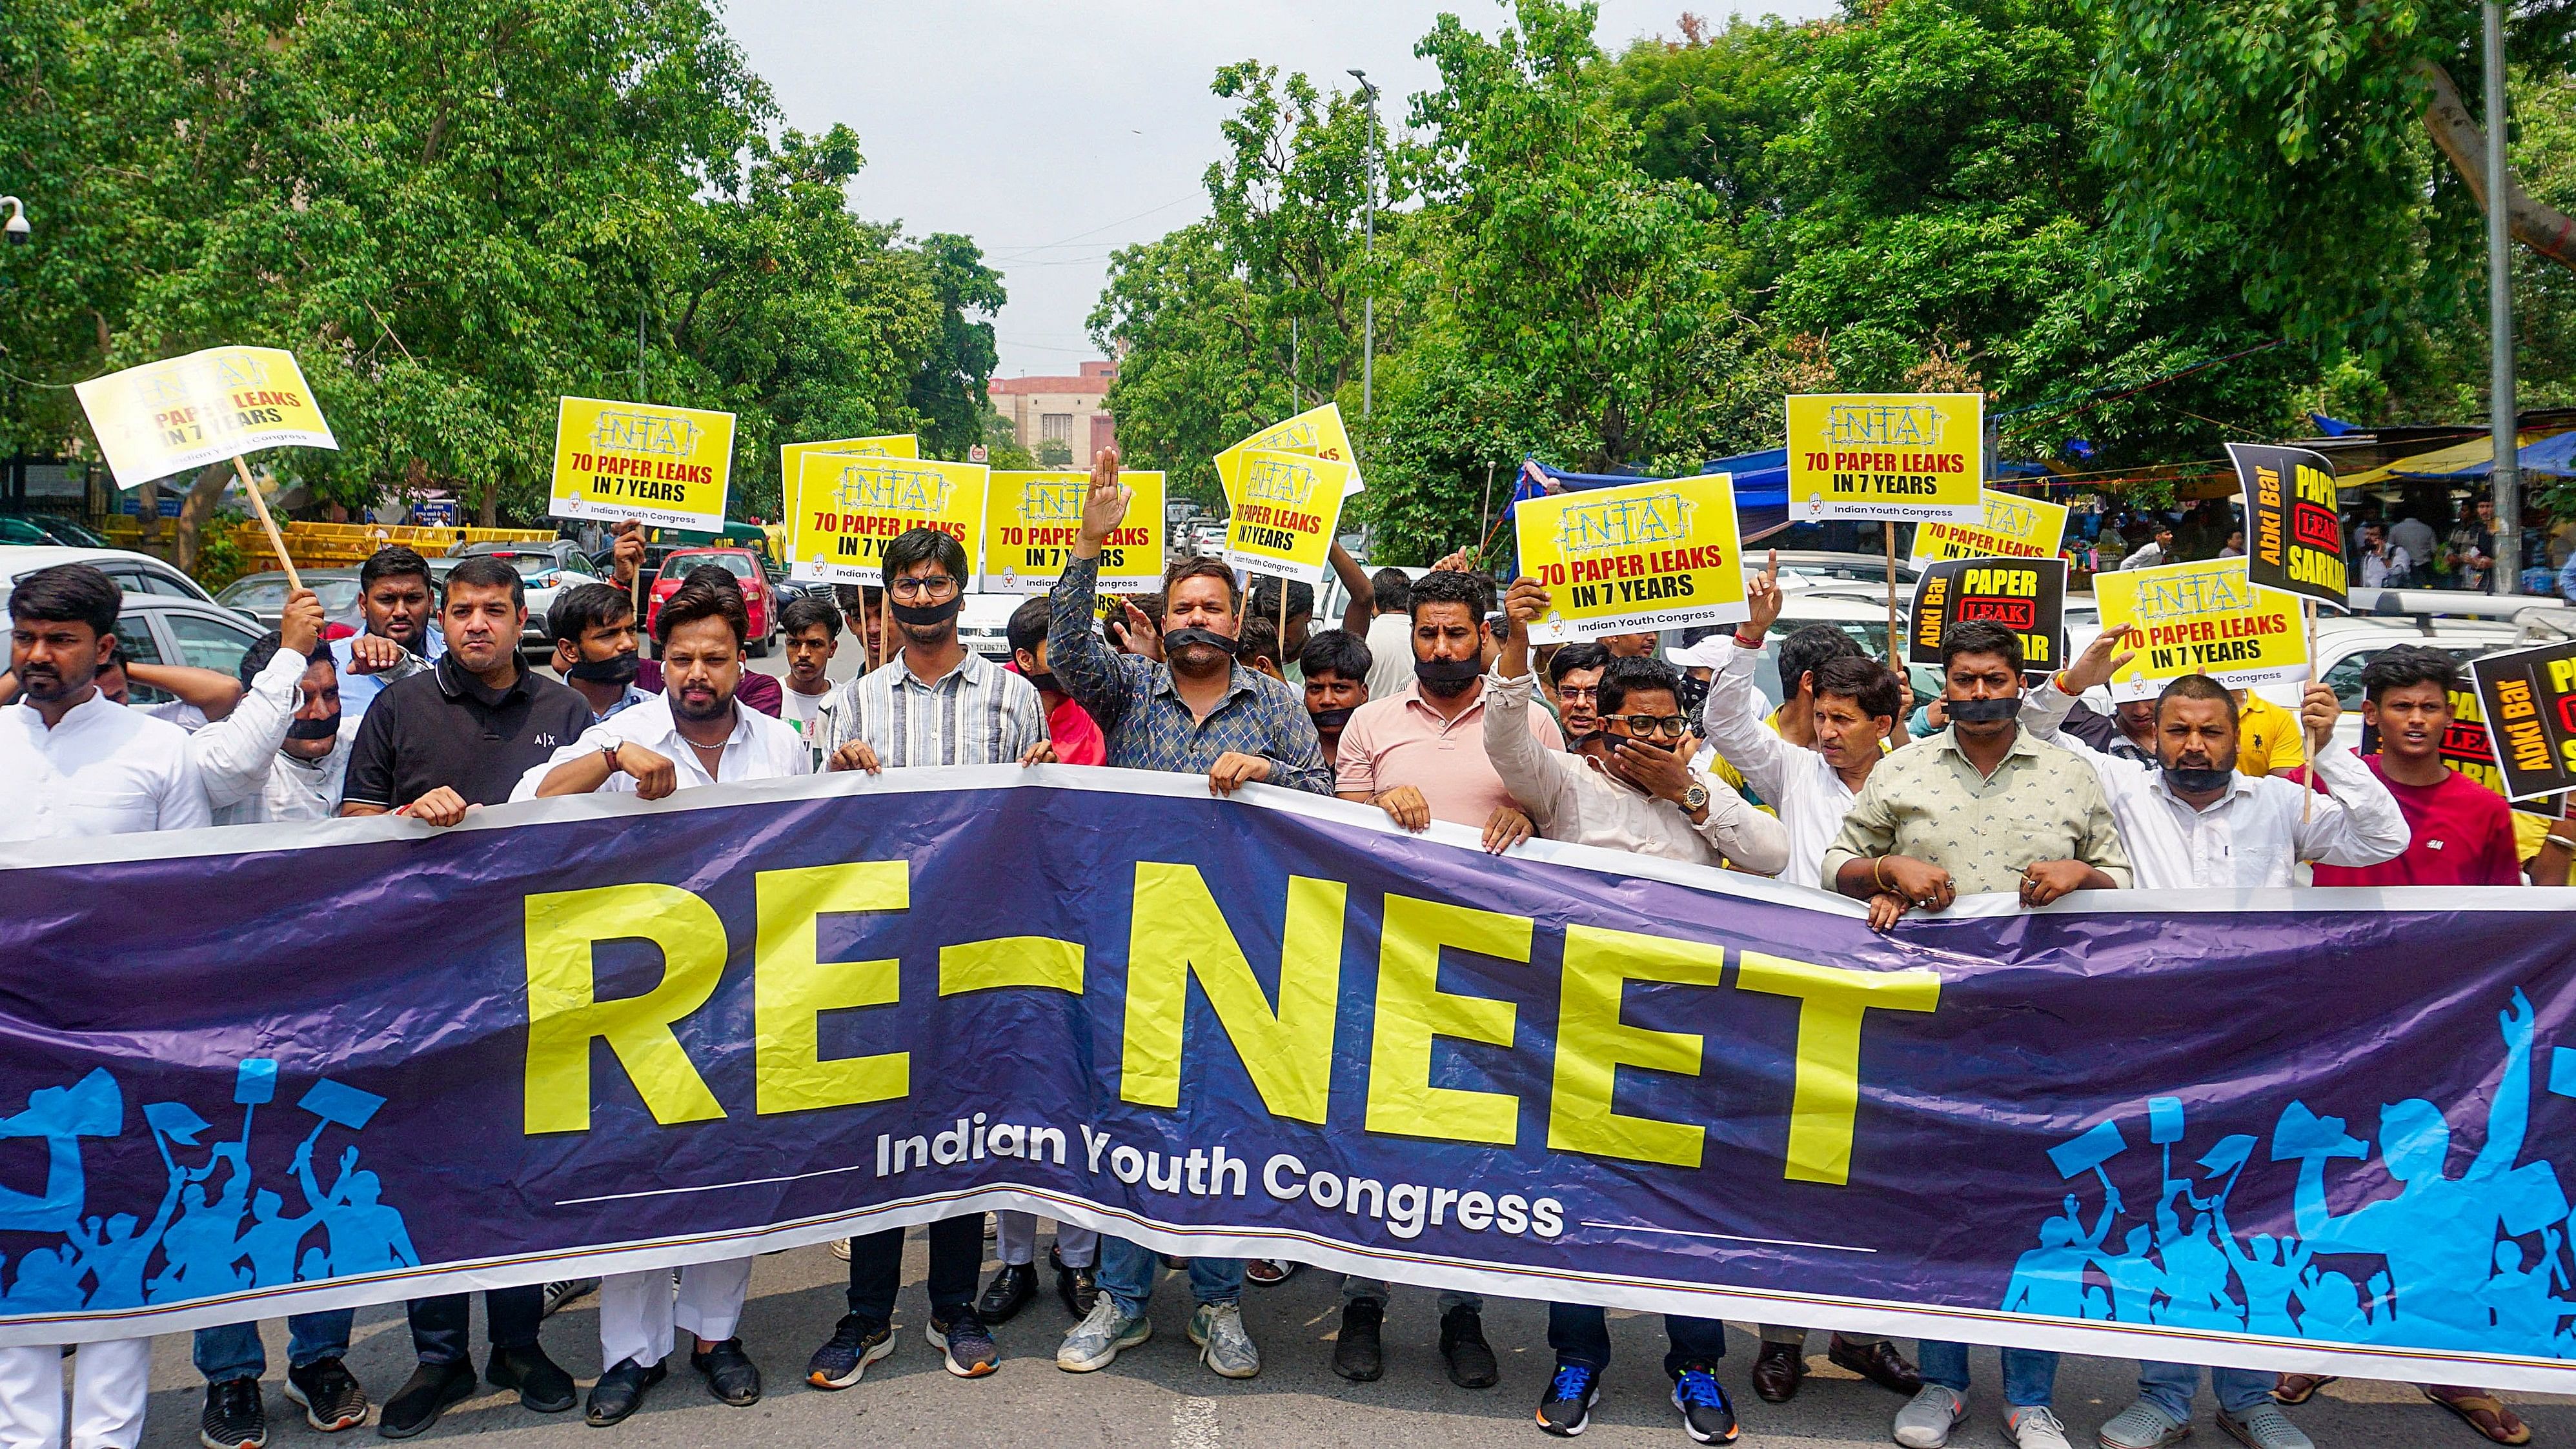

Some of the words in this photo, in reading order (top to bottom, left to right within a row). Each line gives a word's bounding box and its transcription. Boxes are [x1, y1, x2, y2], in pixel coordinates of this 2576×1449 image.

[232, 390, 301, 409] LEAKS
[189, 425, 202, 440] 7
[572, 453, 592, 471] 70
[597, 456, 651, 478] PAPER
[657, 462, 713, 484] LEAKS
[1805, 452, 1829, 471] 70
[1835, 452, 1897, 472] PAPER
[1903, 453, 1965, 474] LEAKS
[593, 476, 611, 494] IN
[616, 478, 629, 495] 7
[630, 480, 685, 502] YEARS
[1833, 474, 1853, 492] IN
[1858, 474, 1871, 492] 7
[1873, 475, 1937, 495] YEARS
[2255, 465, 2280, 508] Bar
[2295, 464, 2338, 513] PAPER
[591, 505, 619, 516] Indian
[622, 509, 647, 518] Youth
[651, 512, 696, 524] Congress
[814, 512, 837, 532] 70
[842, 515, 900, 536] PAPER
[1235, 504, 1244, 520] 70
[1244, 505, 1272, 525] PAPER
[1273, 509, 1321, 534] LEAKS
[1834, 505, 1867, 514] Indian
[1870, 506, 1900, 515] Youth
[1902, 507, 1953, 518] Congress
[1000, 527, 1022, 545] 70
[1029, 528, 1079, 545] PAPE
[1102, 528, 1148, 545] EAKS
[1238, 525, 1247, 542] IN
[1246, 525, 1252, 543] 7
[1252, 526, 1294, 551] YEARS
[1929, 522, 1946, 538] 70
[1949, 527, 1994, 550] PAPER
[1997, 538, 2044, 557] LEAKS
[2260, 510, 2280, 566] Abki
[2302, 512, 2338, 544] LEAK
[838, 537, 858, 555] IN
[863, 538, 872, 556] 7
[1026, 549, 1044, 566] IN
[1051, 549, 1060, 566] 7
[1943, 543, 1960, 558] IN
[1963, 548, 1971, 558] 7
[1245, 558, 1262, 566] Youth
[1263, 560, 1299, 574] Congress
[1537, 563, 1565, 587] 70
[1572, 554, 1644, 583] PAPER
[1650, 545, 1722, 573] LEAKS
[2289, 545, 2347, 596] SARKAR
[1572, 585, 1597, 608] IN
[1601, 583, 1614, 605] 7
[1618, 574, 1695, 603] YEARS
[1924, 576, 1948, 605] Bar
[1963, 569, 2037, 597] PAPER
[1577, 620, 1616, 632] Indian
[1619, 616, 1654, 628] Youth
[1657, 610, 1716, 624] Congress
[1967, 603, 2026, 622] LEAK
[1920, 609, 1943, 648] Abki
[2123, 629, 2145, 650] 70
[2150, 621, 2216, 647] PAPER
[2220, 613, 2287, 639] LEAKS
[2151, 649, 2174, 669] IN
[2176, 647, 2187, 665] 7
[2191, 640, 2262, 664] YEARS
[2227, 672, 2282, 683] Congress
[2496, 680, 2535, 720] Bar
[2446, 729, 2493, 753] LEA
[2504, 720, 2553, 770] Abki
[523, 859, 1941, 1186] RE-NEET
[876, 1111, 1066, 1177] Indian
[1079, 1124, 1248, 1197] Youth
[1263, 1153, 1565, 1239] Congress
